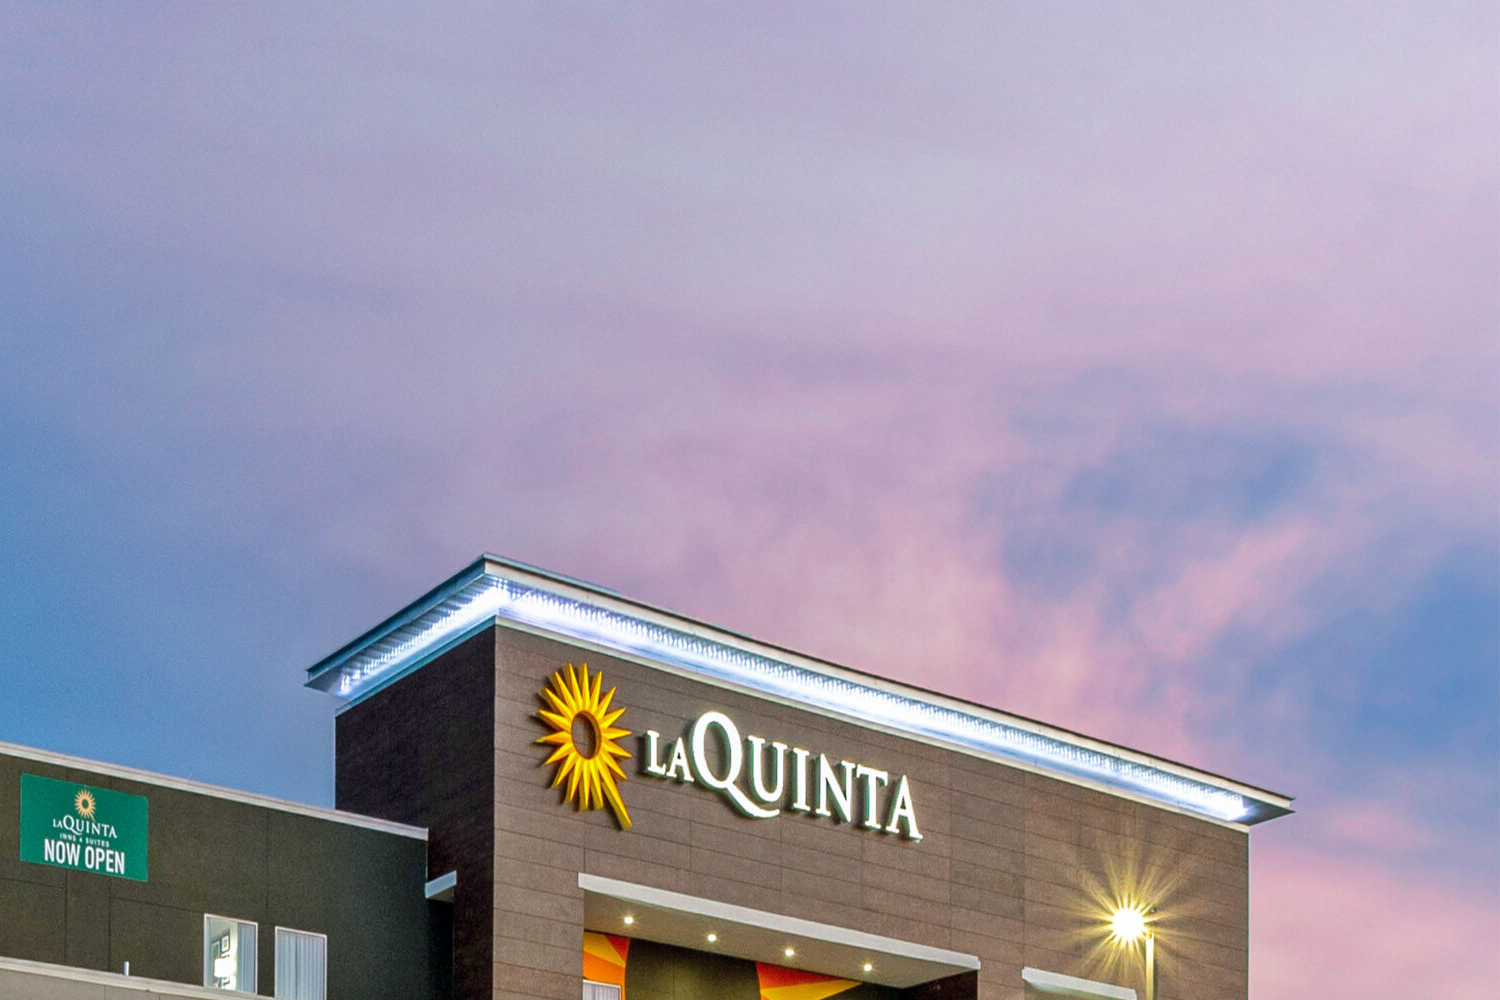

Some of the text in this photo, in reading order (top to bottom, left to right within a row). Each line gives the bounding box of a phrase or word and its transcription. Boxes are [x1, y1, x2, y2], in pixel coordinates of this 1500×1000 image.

[85, 836, 110, 848] SUITES
[44, 838, 125, 875] NOW OPEN
